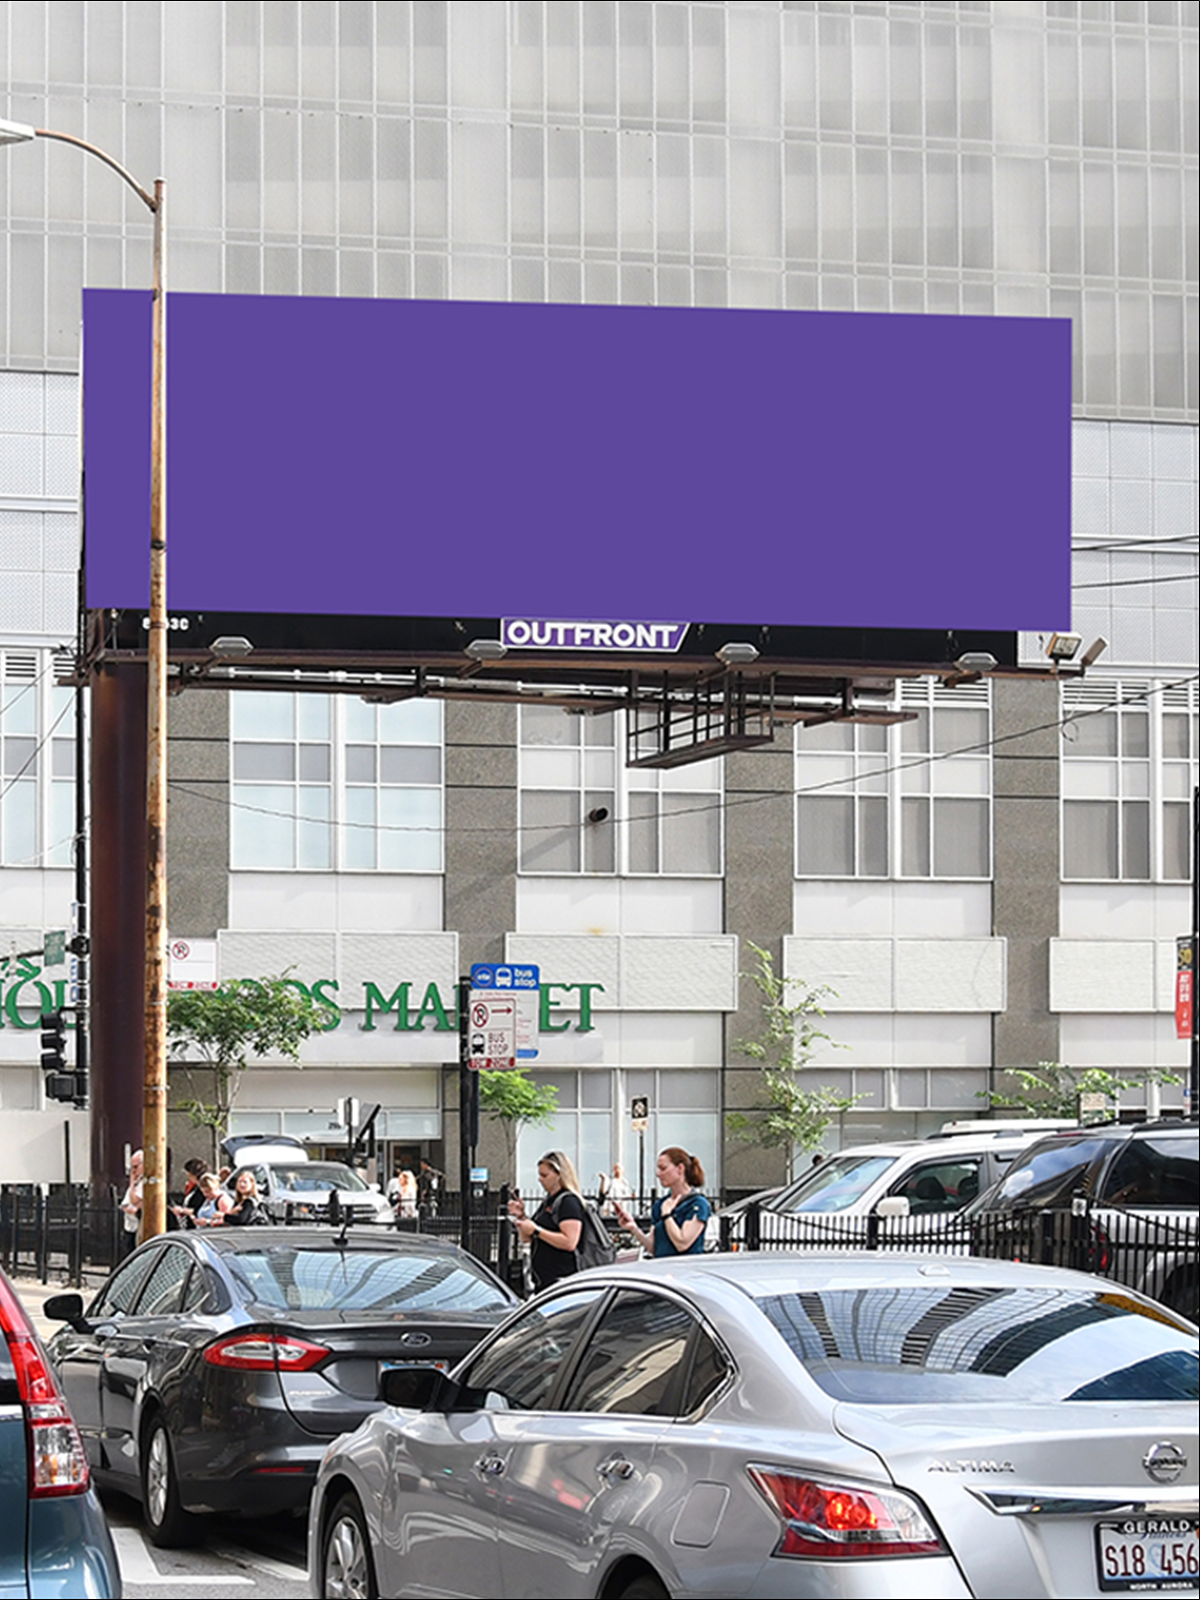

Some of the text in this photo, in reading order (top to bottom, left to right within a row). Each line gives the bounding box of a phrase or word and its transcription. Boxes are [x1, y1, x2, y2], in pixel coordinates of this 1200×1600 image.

[506, 620, 679, 648] OUTFRONT
[514, 968, 533, 978] bus
[514, 979, 536, 988] stop
[360, 982, 605, 1031] MAET
[488, 1032, 504, 1043] BUS
[488, 1044, 509, 1056] STOP
[927, 1459, 1016, 1474] ALTIMA
[1123, 1520, 1190, 1534] GERALD
[1105, 1542, 1199, 1577] S18 456
[1129, 1582, 1193, 1591] NORTH AURORA
